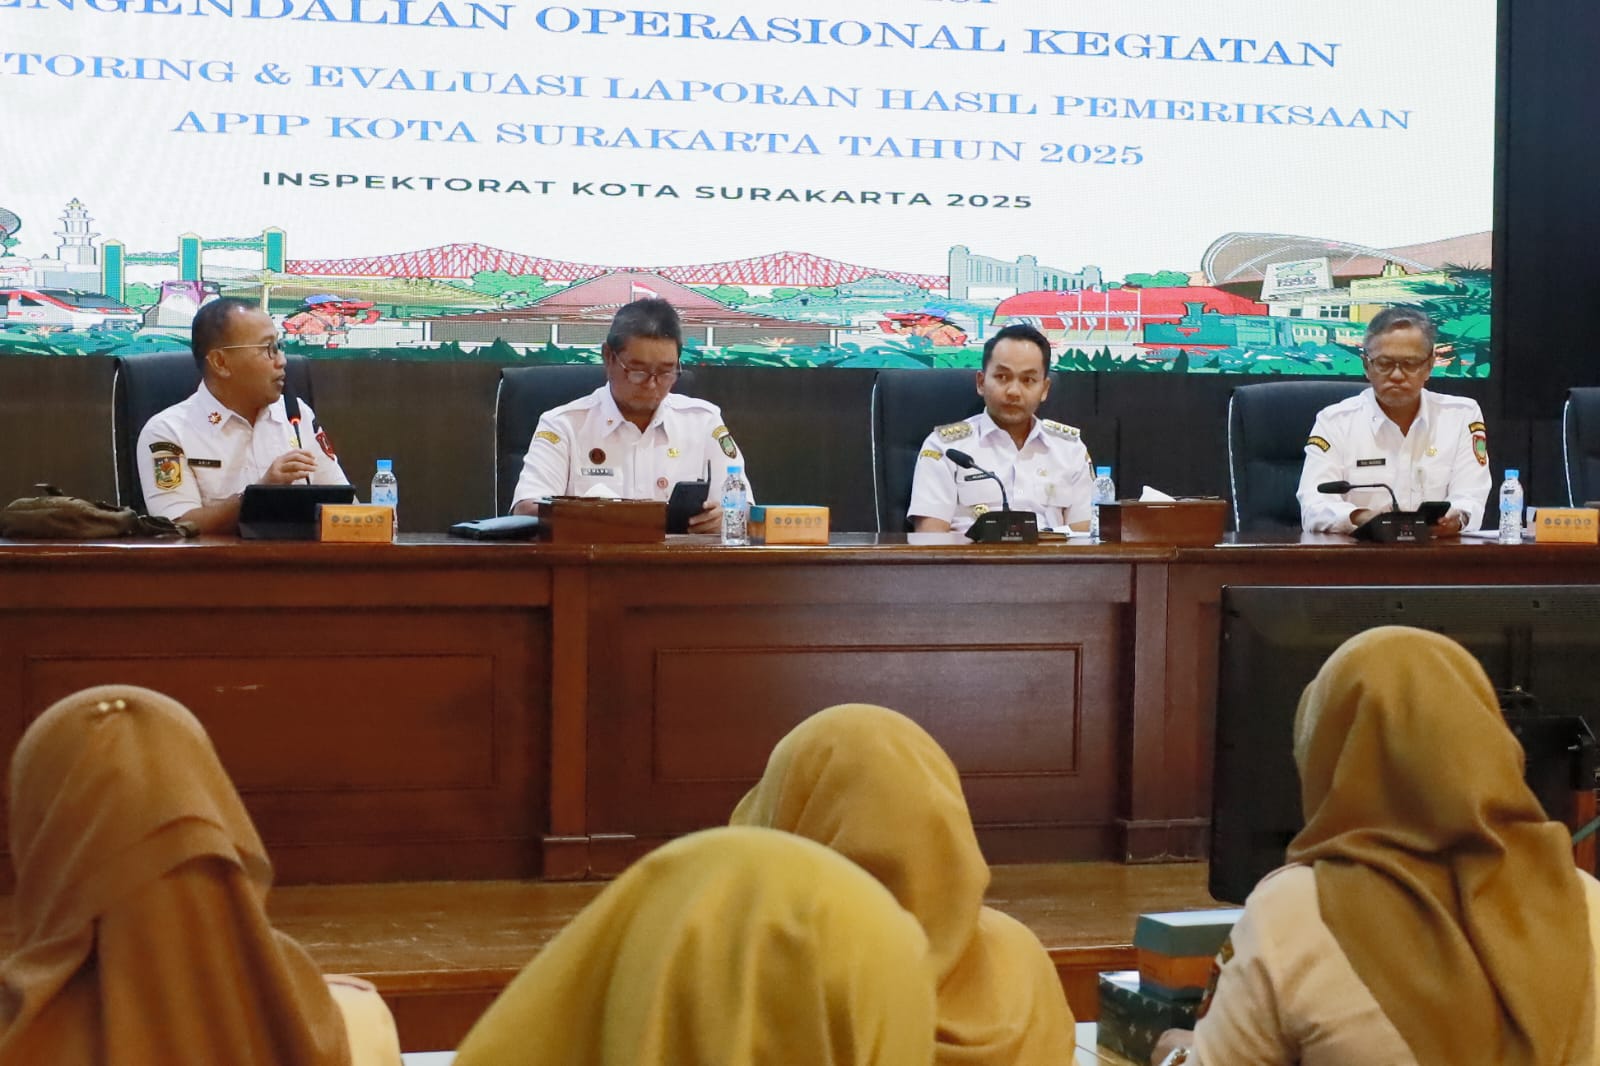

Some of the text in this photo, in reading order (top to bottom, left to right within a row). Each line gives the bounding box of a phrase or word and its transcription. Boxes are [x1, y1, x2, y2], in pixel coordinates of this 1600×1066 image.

[0, 0, 1341, 68] GENDALIAN OPERASIONAL KEGIATAN
[0, 52, 1412, 130] TORING & EVALUASI LAPORAN HASIL PEMERIKSAAN
[171, 110, 1144, 166] APIP KOTA SURAKARTA TAHUN 2025
[263, 172, 1032, 209] INSPEKTORAT KOTA SURAKARTA 2025
